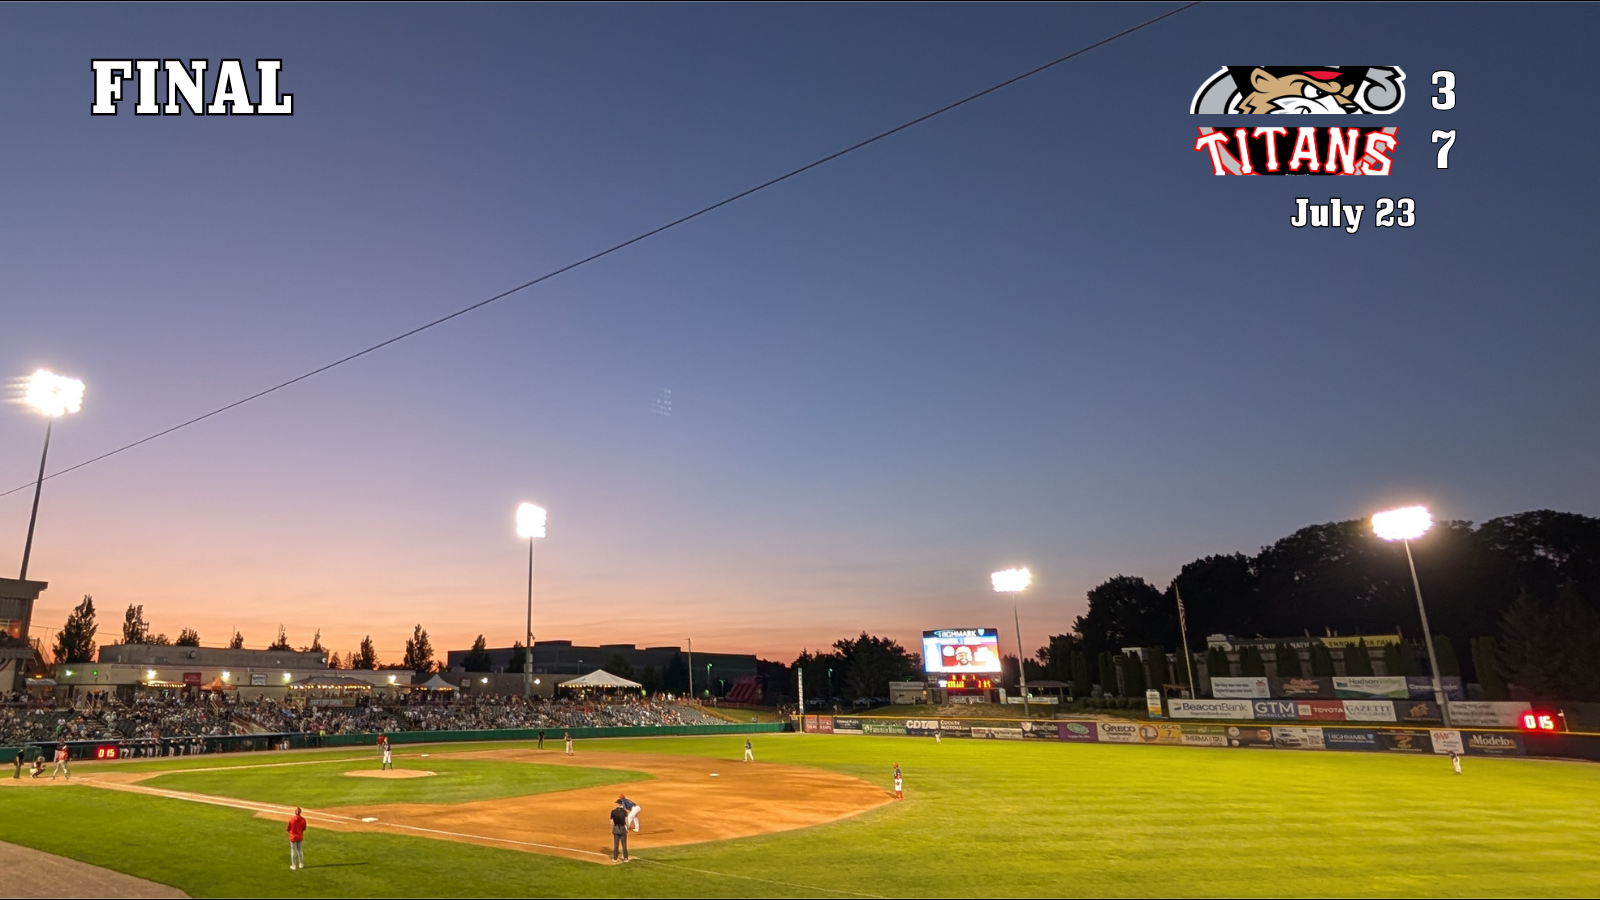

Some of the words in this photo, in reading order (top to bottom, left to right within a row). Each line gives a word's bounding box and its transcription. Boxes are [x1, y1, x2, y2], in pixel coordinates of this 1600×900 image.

[1182, 702, 1248, 711] BeaconBank
[1254, 702, 1295, 714] GTM
[1101, 723, 1136, 732] GRECO
[1472, 734, 1510, 746] Modelo
